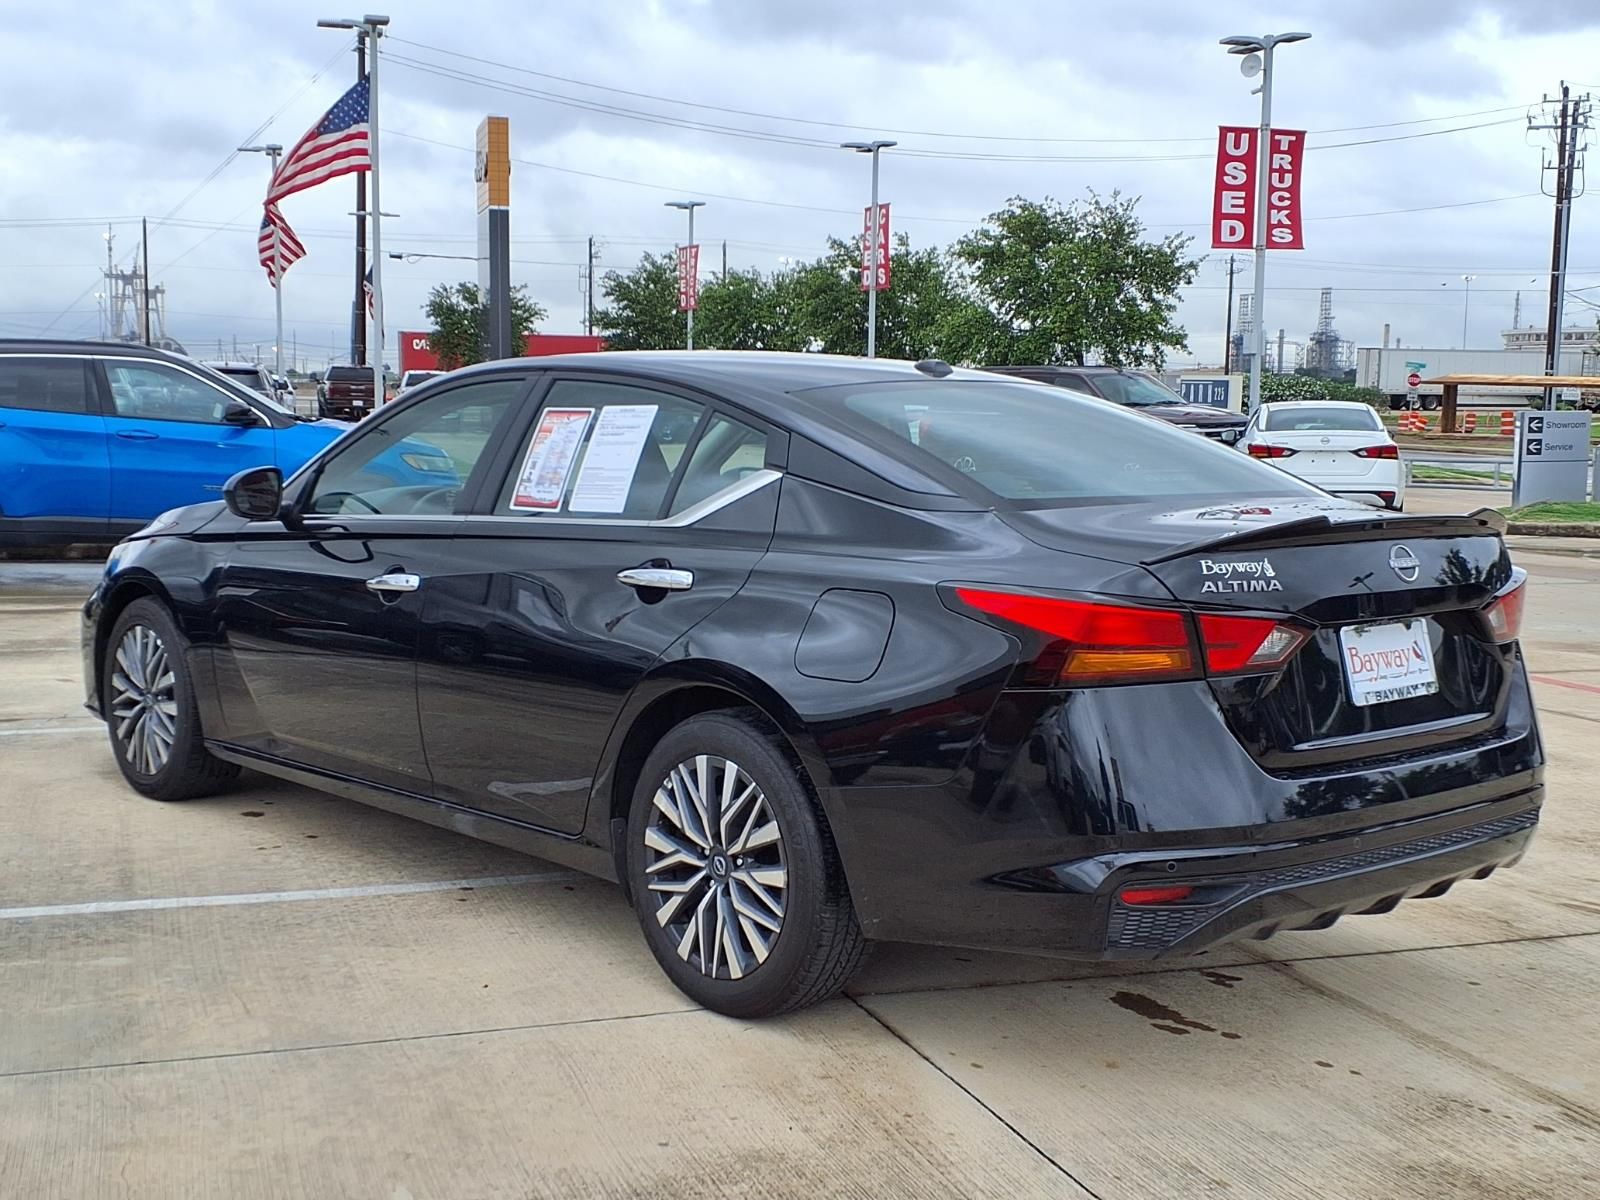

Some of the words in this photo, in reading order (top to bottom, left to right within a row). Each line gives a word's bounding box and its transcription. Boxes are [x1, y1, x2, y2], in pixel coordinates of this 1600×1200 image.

[1220, 132, 1249, 243] USED
[1270, 134, 1296, 243] TRUCKS
[863, 211, 872, 286] USED
[878, 208, 886, 285] CARS
[1546, 421, 1587, 429] Showroom
[1544, 442, 1574, 451] Service
[1199, 559, 1263, 579] Bayway
[1200, 579, 1284, 594] ALTIMA
[1347, 646, 1410, 682] Bayway
[1374, 685, 1417, 702] BAYWAY
